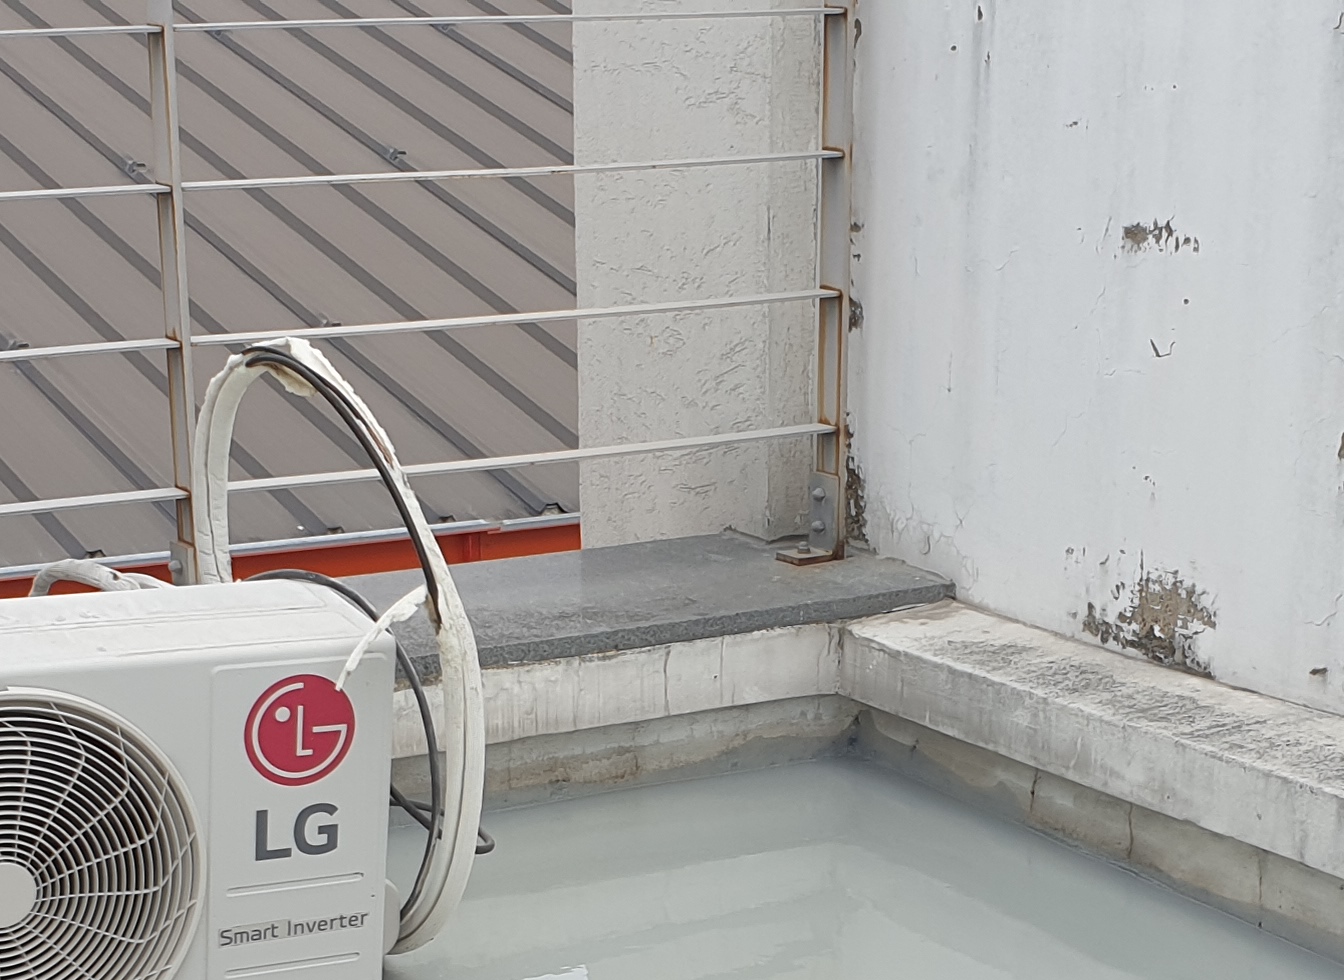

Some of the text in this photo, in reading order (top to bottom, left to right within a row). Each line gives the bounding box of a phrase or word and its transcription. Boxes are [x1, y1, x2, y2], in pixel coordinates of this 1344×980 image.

[254, 803, 339, 861] LG
[219, 911, 369, 947] Smart Inverter
